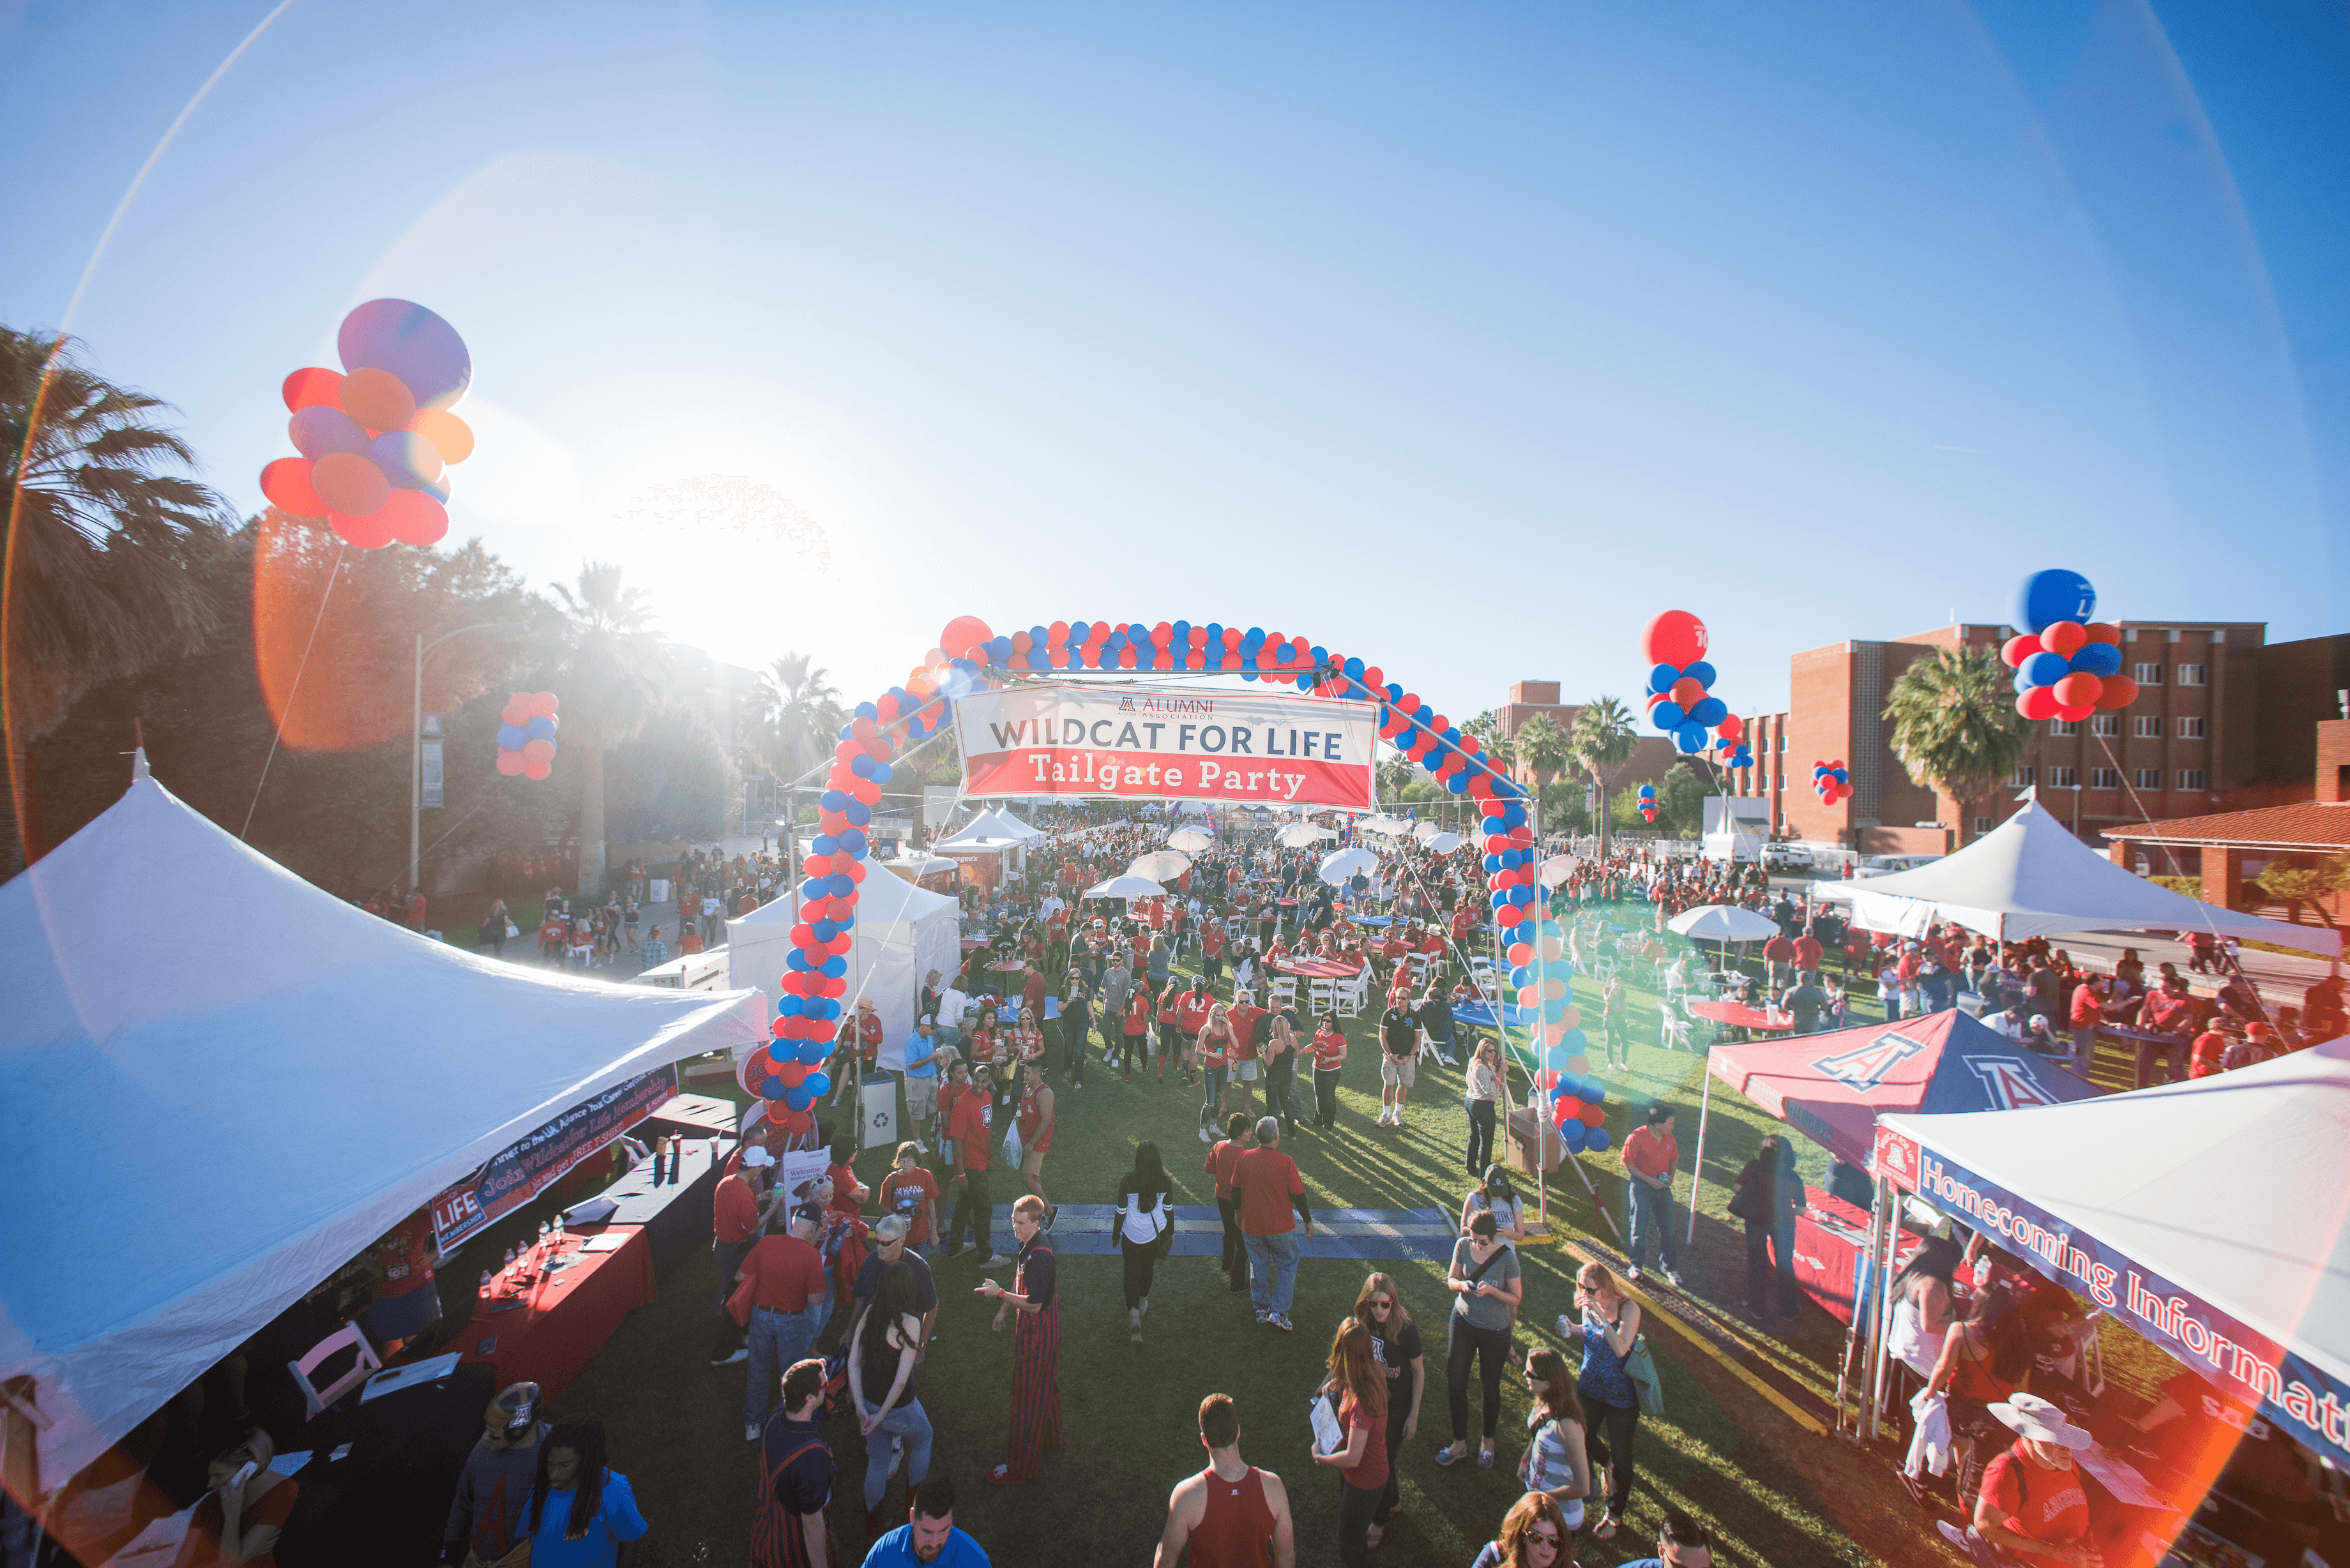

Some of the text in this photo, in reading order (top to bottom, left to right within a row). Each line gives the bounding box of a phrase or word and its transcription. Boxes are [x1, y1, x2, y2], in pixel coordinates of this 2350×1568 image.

[1142, 698, 1213, 712] ALUMNI
[990, 718, 1342, 760] WILDCAT FOR LIFE
[1028, 753, 1307, 799] Tailgate Party
[1188, 997, 1206, 1013] 42
[1811, 1032, 1927, 1092] A
[484, 1168, 526, 1197] Join
[791, 1166, 822, 1177] Welcome,
[436, 1191, 478, 1232] LIFE
[441, 1212, 483, 1242] MEMBERSHIP
[1922, 1154, 2117, 1309] Homecoming
[509, 1402, 532, 1429] A
[2043, 1488, 2088, 1523] ARIZONA
